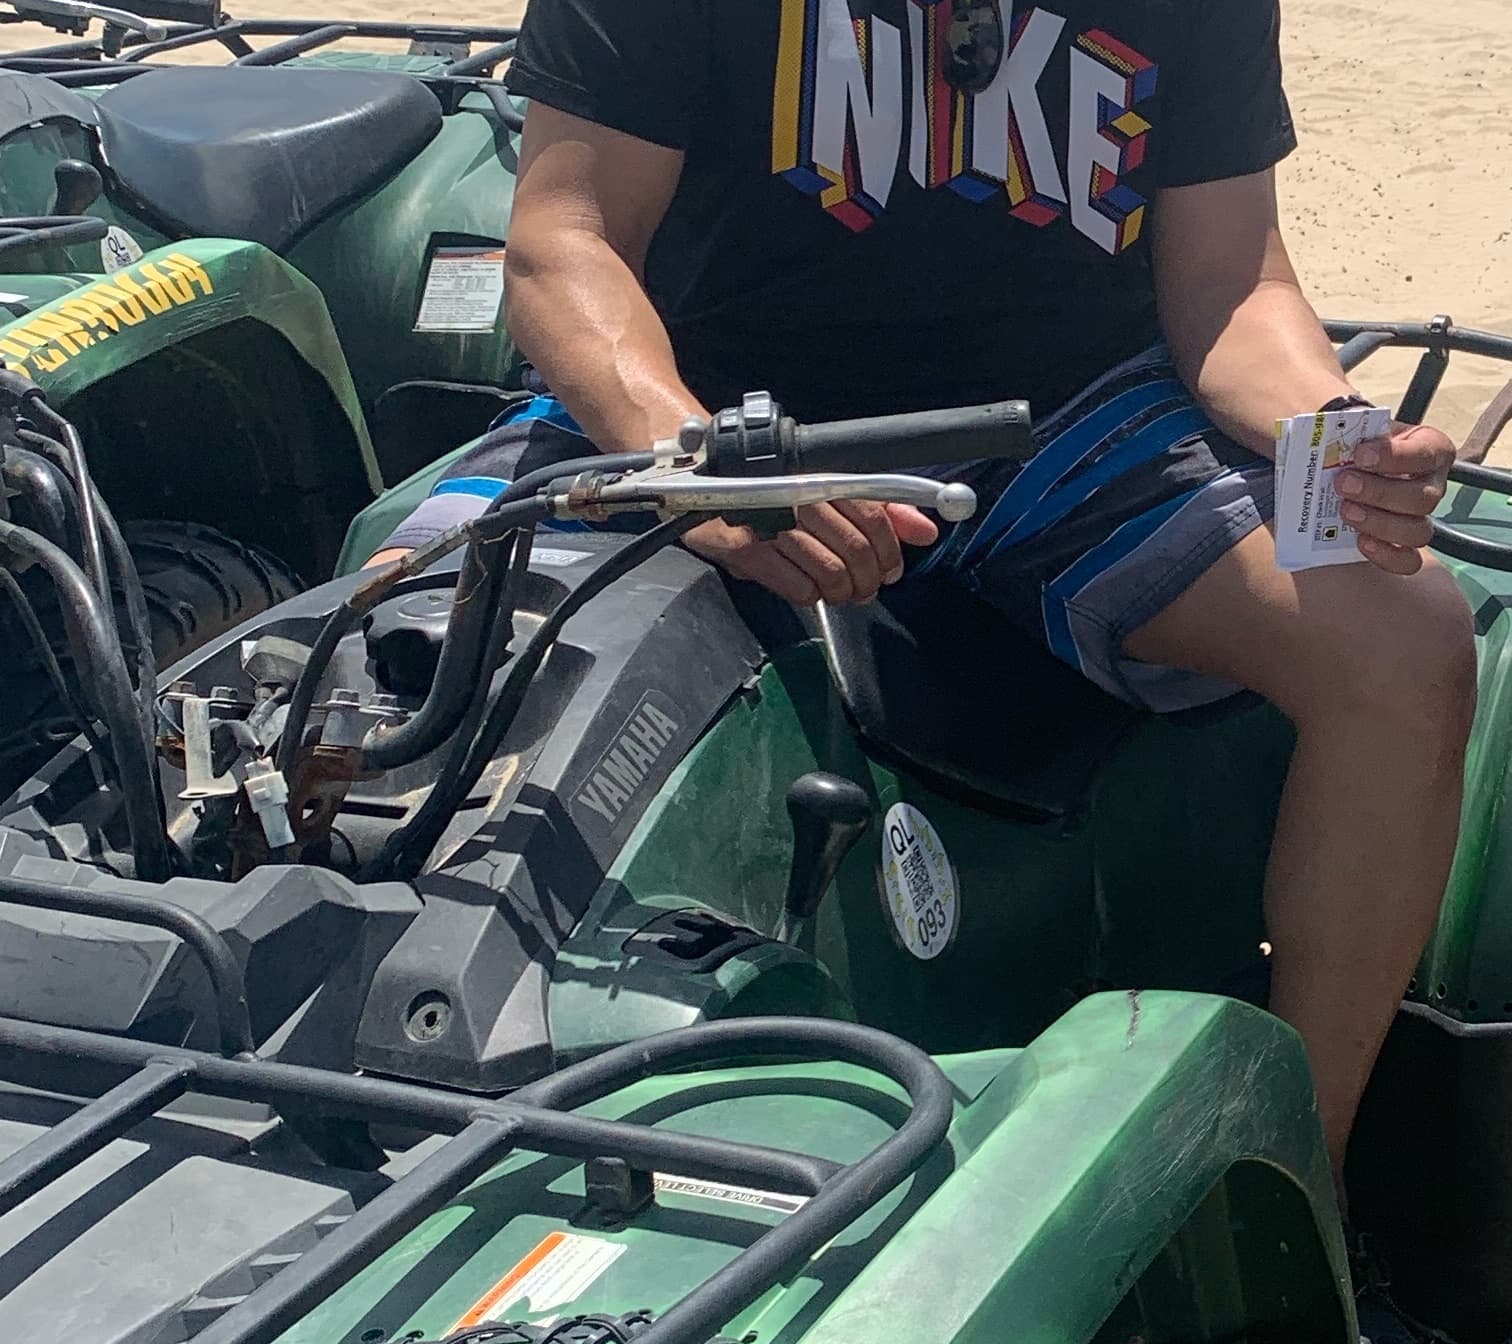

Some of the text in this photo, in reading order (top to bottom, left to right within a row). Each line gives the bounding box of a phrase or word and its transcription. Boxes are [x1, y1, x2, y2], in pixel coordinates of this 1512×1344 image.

[1297, 487, 1316, 534] Recovery
[577, 700, 680, 824] YAMAHA
[889, 818, 915, 856] QL
[917, 899, 947, 947] 093
[653, 1179, 764, 1204] DRIVE SELECT LEV
